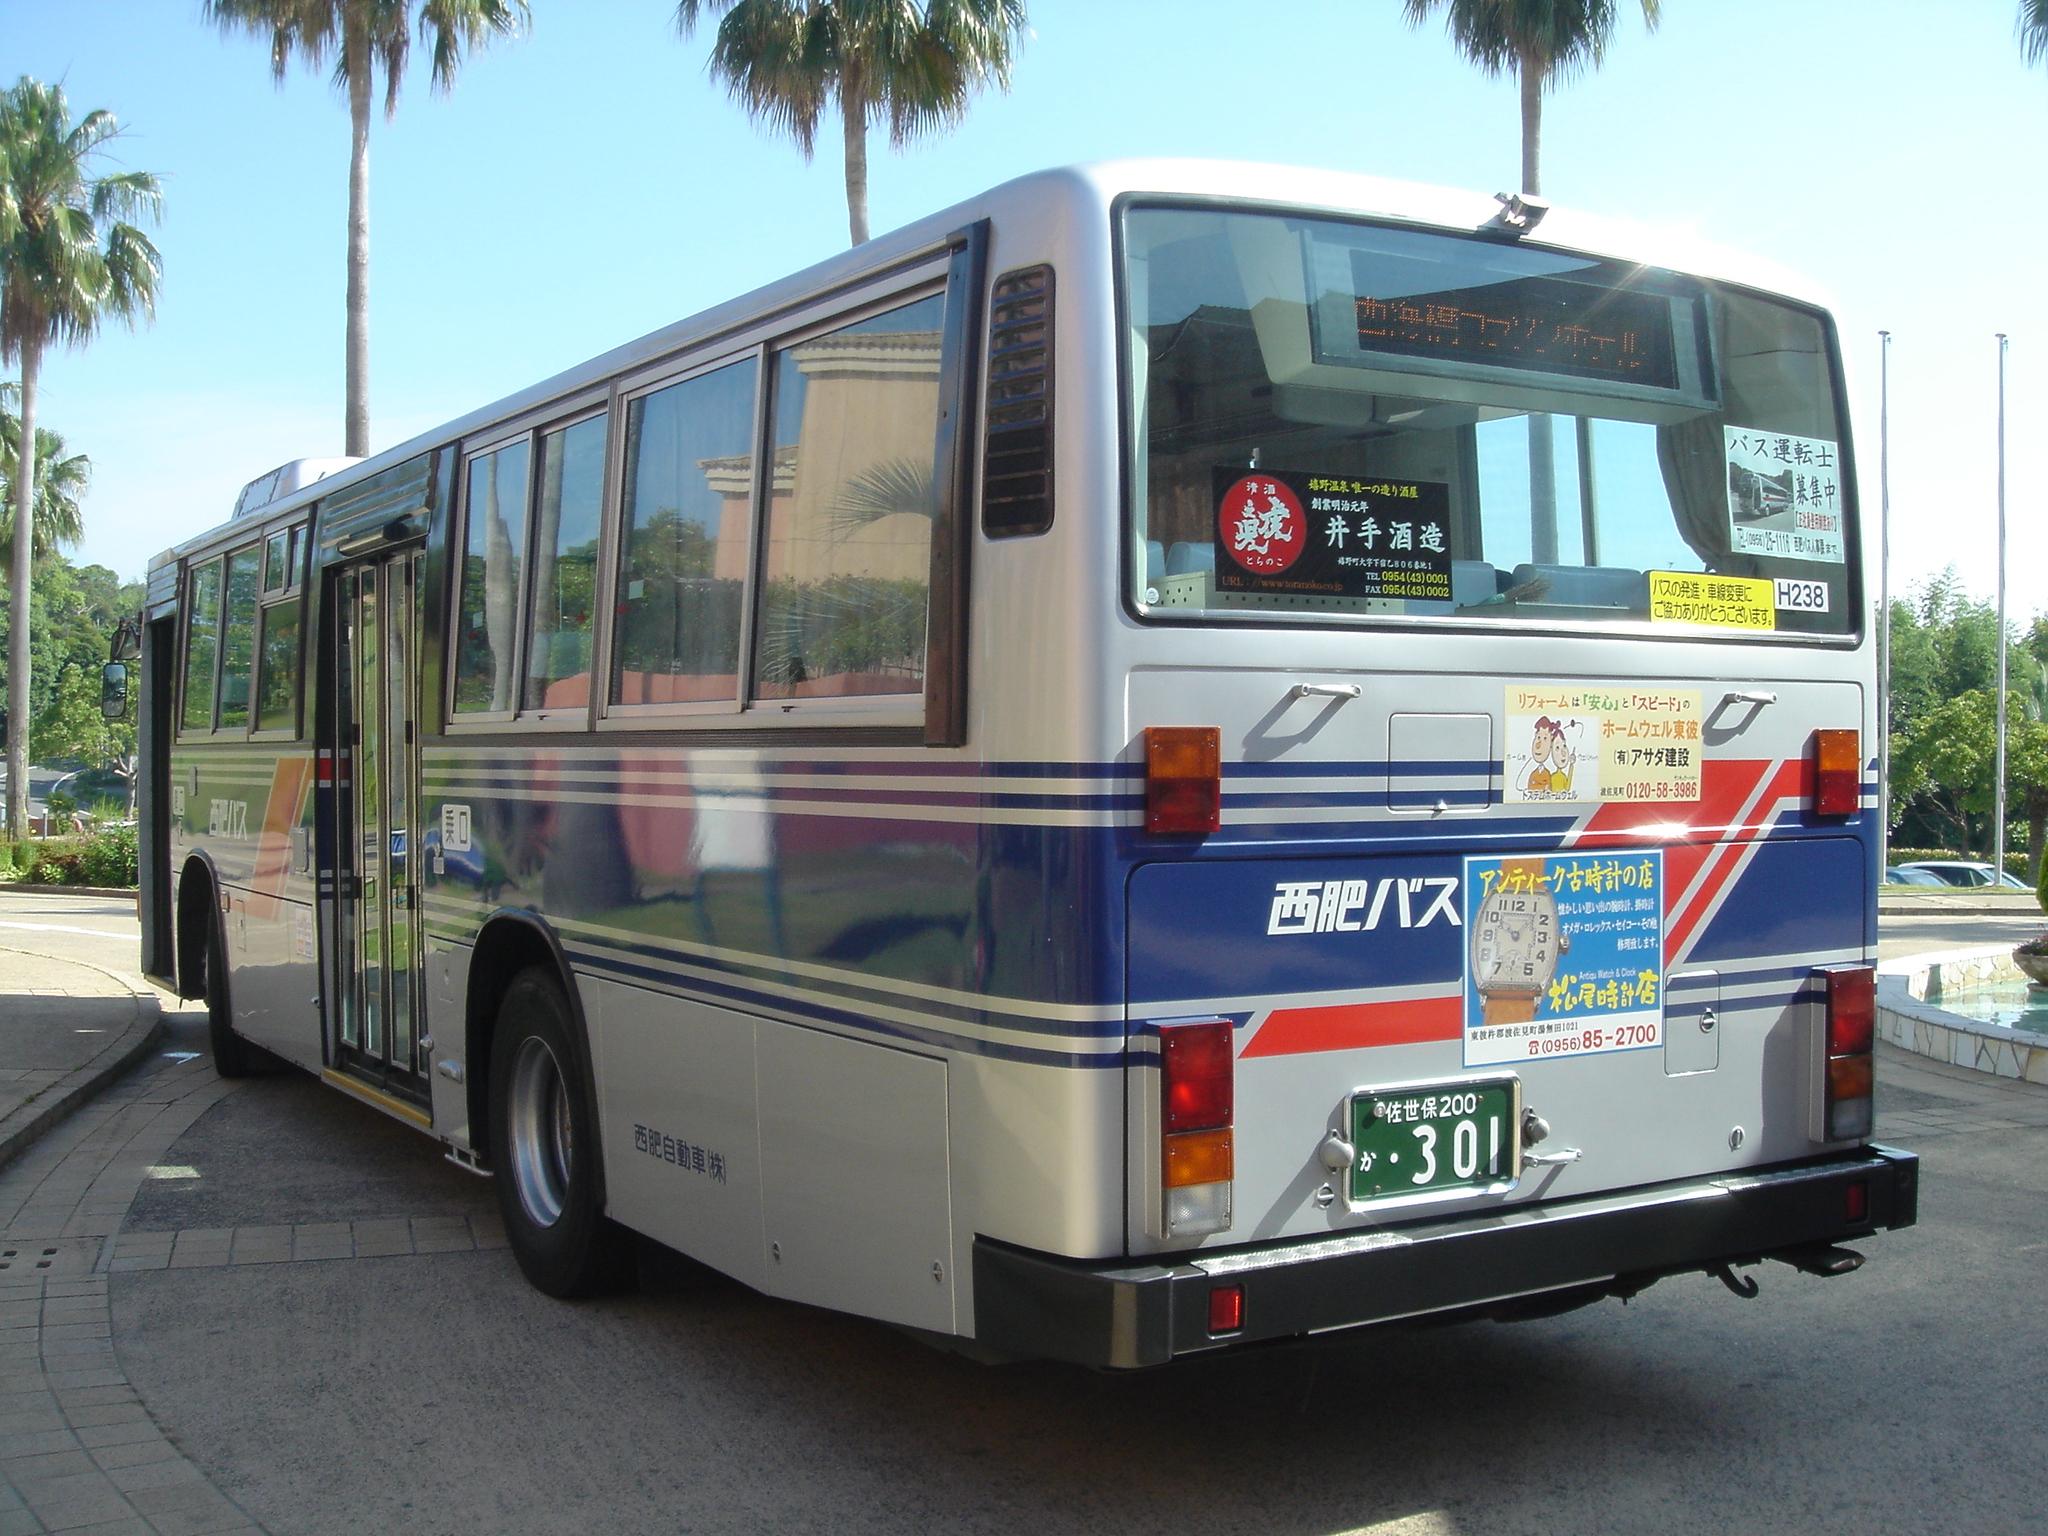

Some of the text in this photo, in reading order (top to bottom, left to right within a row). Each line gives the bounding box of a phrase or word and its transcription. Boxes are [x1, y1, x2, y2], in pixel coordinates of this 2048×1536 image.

[1729, 435, 1833, 468] バス運転士
[1246, 481, 1275, 495] 清酒
[1795, 473, 1836, 509] 募集中
[1325, 515, 1446, 553] 井手酒造
[1246, 556, 1283, 567] とらのこ
[1365, 571, 1449, 584] TEL 0954(43)0001
[1365, 584, 1449, 597] FAX 0954(43)0002
[1652, 579, 1753, 602] バスの発進・車線変更に
[1778, 581, 1824, 609] H238
[1654, 600, 1772, 626] ご協力ありがとうございます。
[1602, 719, 1698, 740] ホームウェル東彼
[1613, 747, 1690, 768] (有)アサダ建設
[1626, 782, 1697, 799] 0120-58-3986
[1479, 859, 1654, 898] アンティーク古時計の店
[1267, 877, 1463, 936] 西肥バス
[1511, 900, 1525, 912] 12
[1485, 911, 1499, 923] 10
[1539, 914, 1549, 926] 2
[1537, 931, 1547, 944] 3
[1536, 950, 1546, 963] 4
[1492, 961, 1502, 975] 7
[1523, 962, 1534, 976] 5
[1621, 967, 1636, 977] Clock
[1548, 968, 1659, 1013] 松尾時計店
[1542, 1024, 1656, 1054] (0956)85-2700
[1385, 1092, 1477, 1124] 佐世保200
[634, 1124, 726, 1185] 西肥自動車(株)
[1359, 1151, 1377, 1172] か
